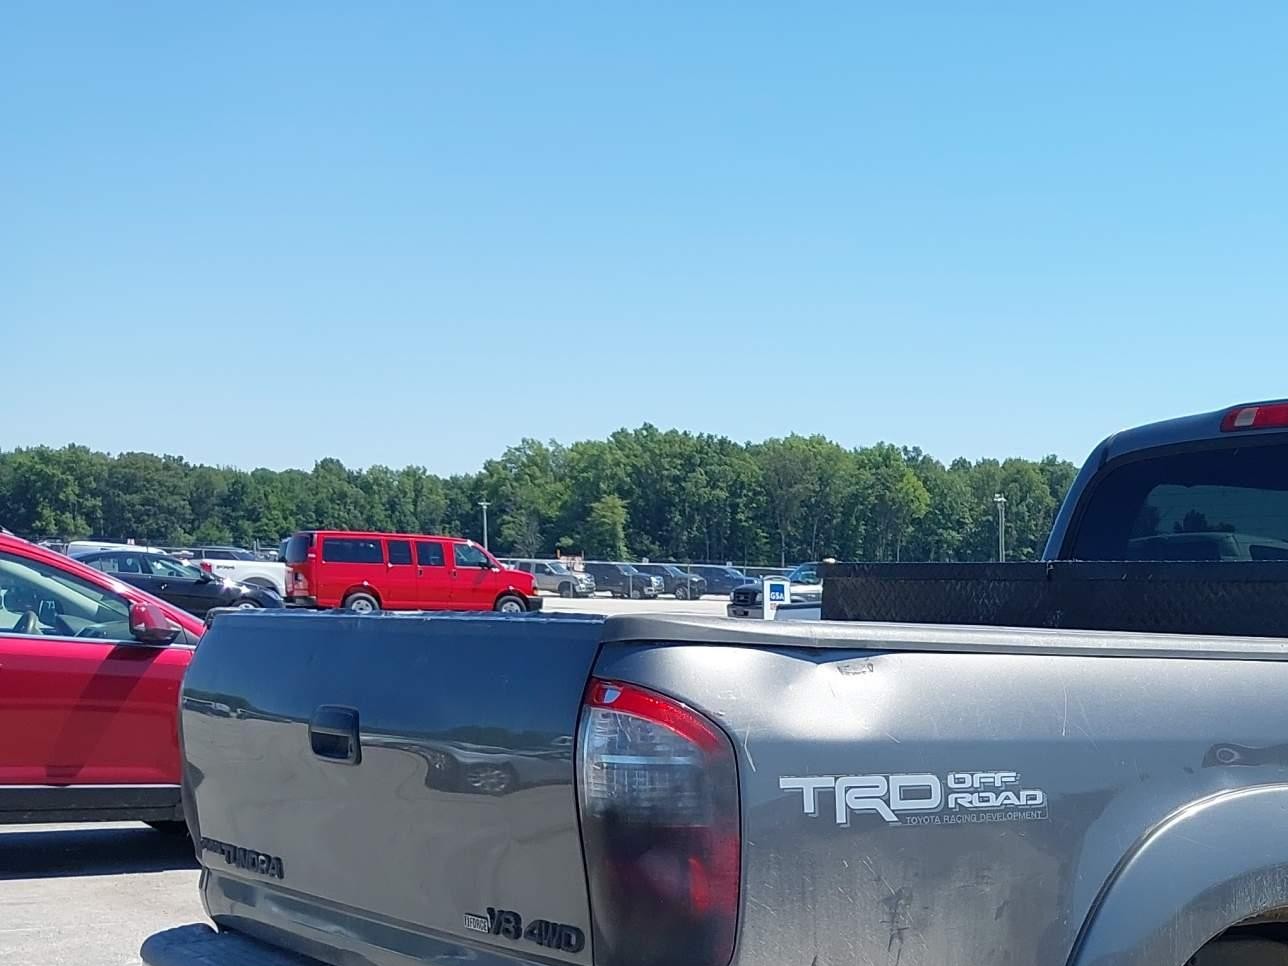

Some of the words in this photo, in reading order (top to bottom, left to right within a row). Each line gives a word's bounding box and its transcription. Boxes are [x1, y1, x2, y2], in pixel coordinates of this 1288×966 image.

[779, 773, 943, 825] TRD
[946, 772, 1018, 789] OFF
[947, 789, 1046, 810] ROAD
[905, 815, 942, 826] TOYOTA
[943, 813, 977, 824] RACING
[979, 810, 1044, 823] DEVELOPMENT
[223, 846, 285, 880] TUNDRA
[486, 906, 523, 941] V8
[523, 918, 586, 954] 4WD
